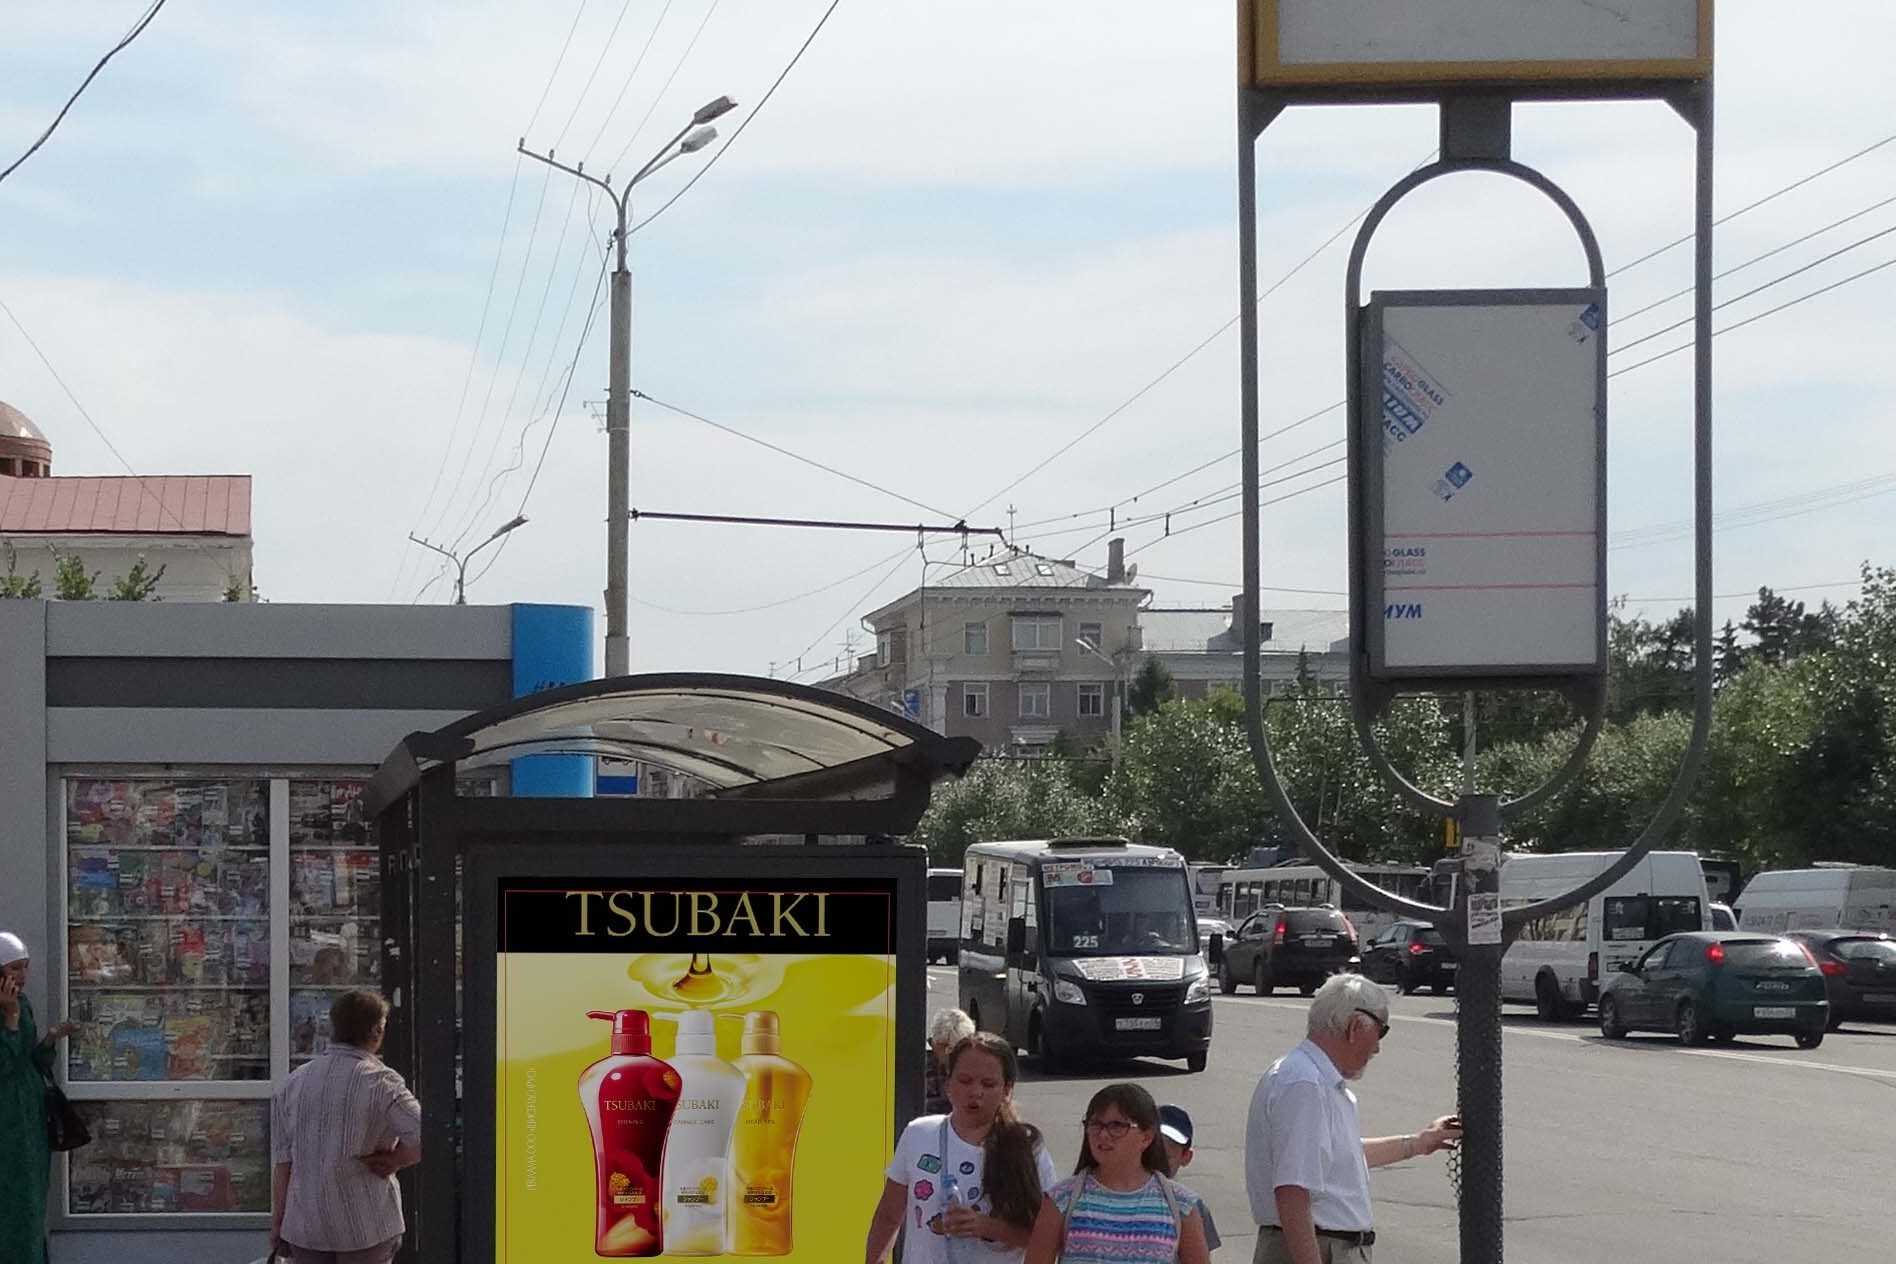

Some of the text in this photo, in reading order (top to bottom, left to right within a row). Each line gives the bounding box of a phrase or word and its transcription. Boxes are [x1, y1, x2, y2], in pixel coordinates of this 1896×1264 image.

[565, 889, 832, 938] TSUBAKI
[1073, 935, 1099, 949] 225
[604, 1100, 656, 1111] TSUBAKI
[677, 1099, 720, 1111] SUBAKI
